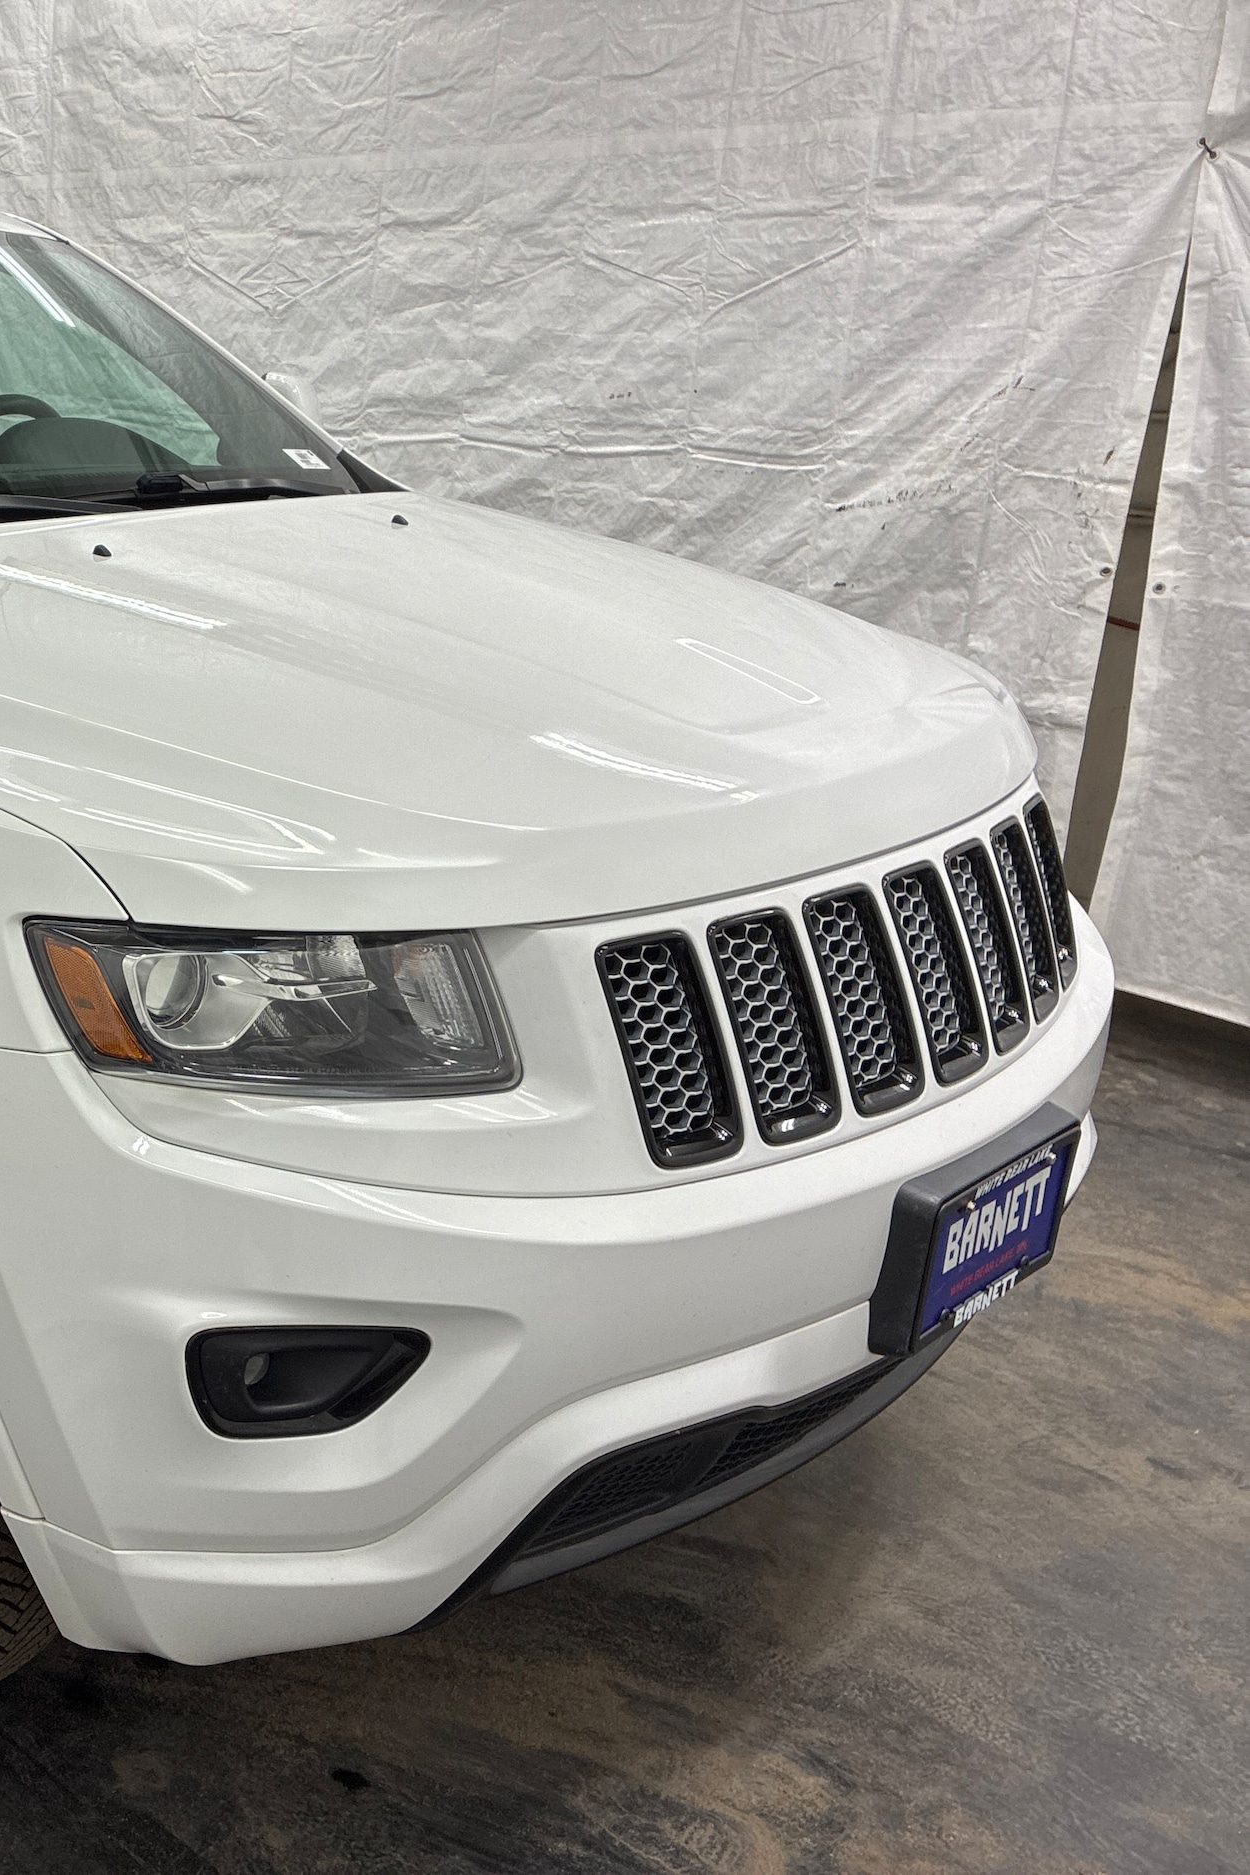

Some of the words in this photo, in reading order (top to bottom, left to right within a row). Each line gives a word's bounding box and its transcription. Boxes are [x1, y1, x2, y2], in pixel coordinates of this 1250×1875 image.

[974, 1171, 1006, 1200] WHITE
[1003, 1158, 1030, 1183] BEAR
[1027, 1144, 1054, 1169] LAKE
[942, 1166, 1052, 1275] BARNETT
[953, 1269, 1019, 1328] BARNETT
